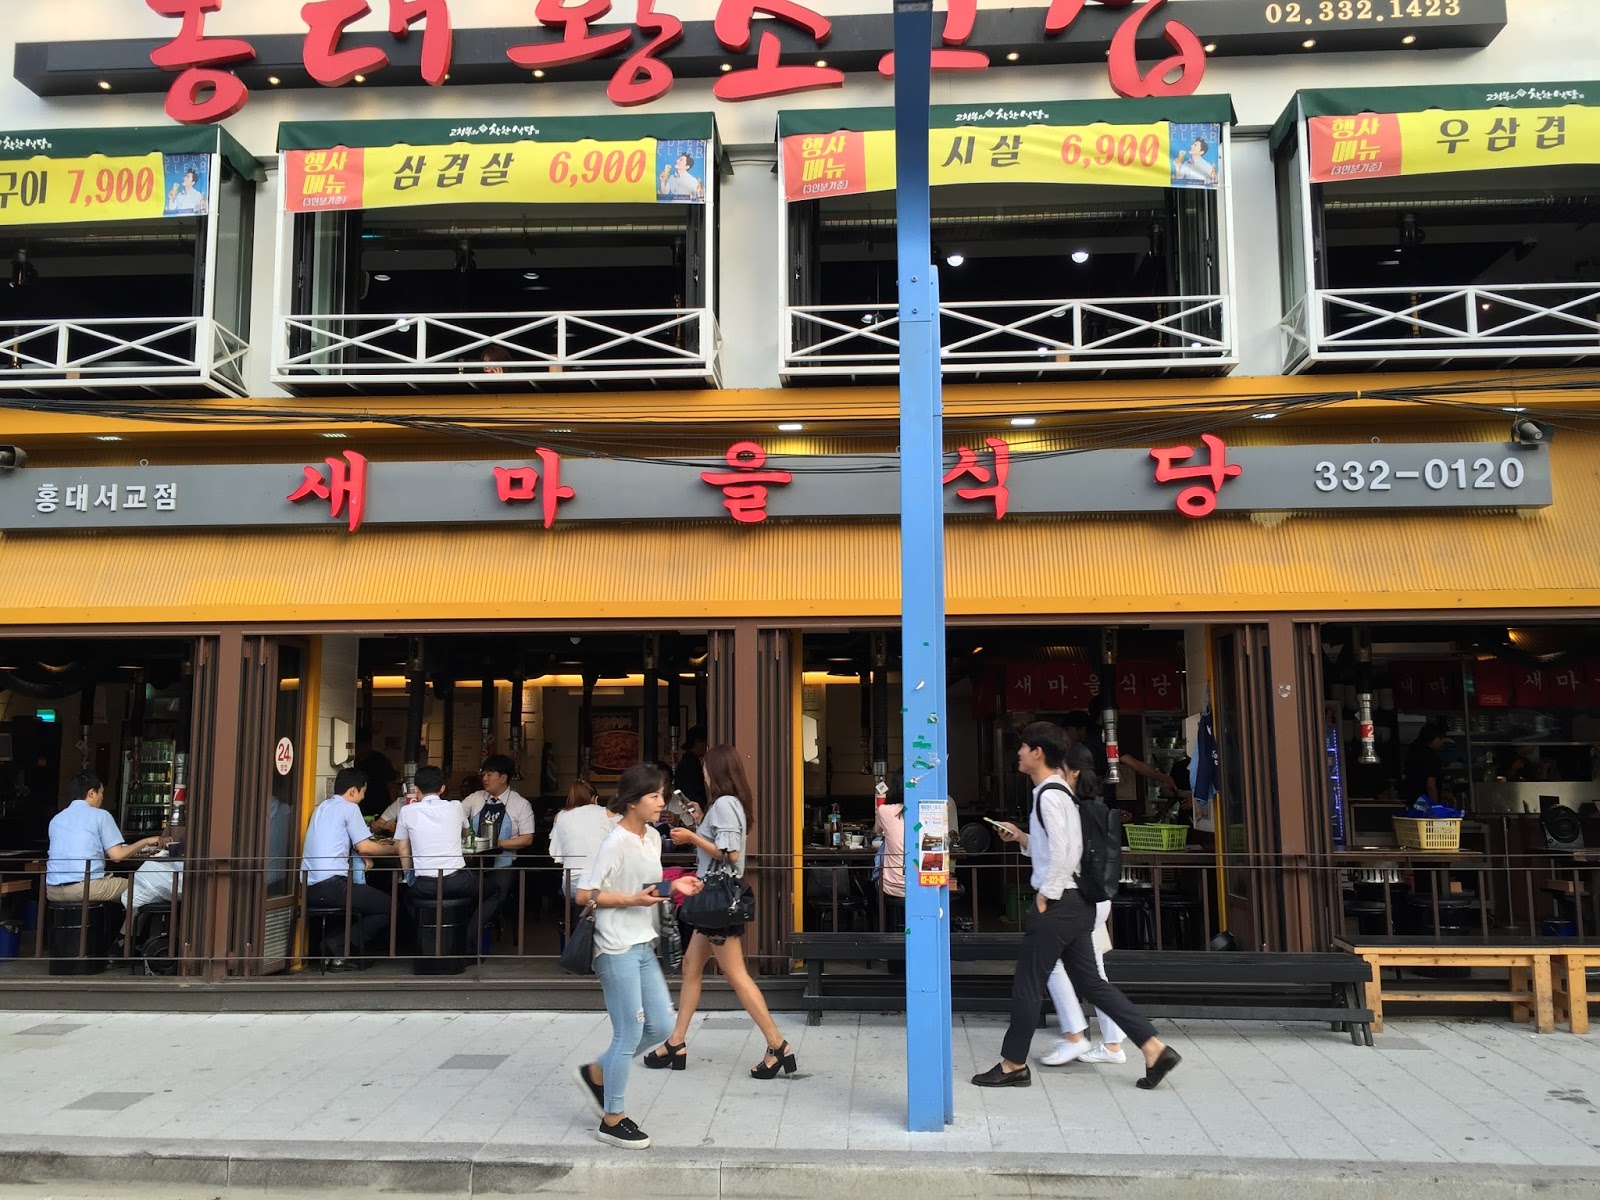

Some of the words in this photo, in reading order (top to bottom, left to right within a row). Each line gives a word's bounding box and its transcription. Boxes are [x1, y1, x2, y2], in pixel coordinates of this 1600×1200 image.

[1265, 0, 1461, 25] 02.332.1423
[1170, 131, 1218, 142] CLEAR
[1331, 118, 1380, 139] 행사
[1436, 115, 1566, 154] 우삼겹
[802, 136, 846, 158] 행사
[941, 135, 1024, 168] 시살
[1060, 133, 1160, 169] 6,900
[1331, 139, 1381, 163] 메뉴
[304, 151, 347, 173] 행사
[393, 152, 515, 191] 삼겹살
[549, 150, 647, 187] 6,900
[801, 159, 846, 181] 메뉴
[67, 166, 154, 207] 7,900
[303, 174, 347, 195] 메뉴
[1315, 457, 1525, 493] 332-0120
[173, 788, 181, 801] 7
